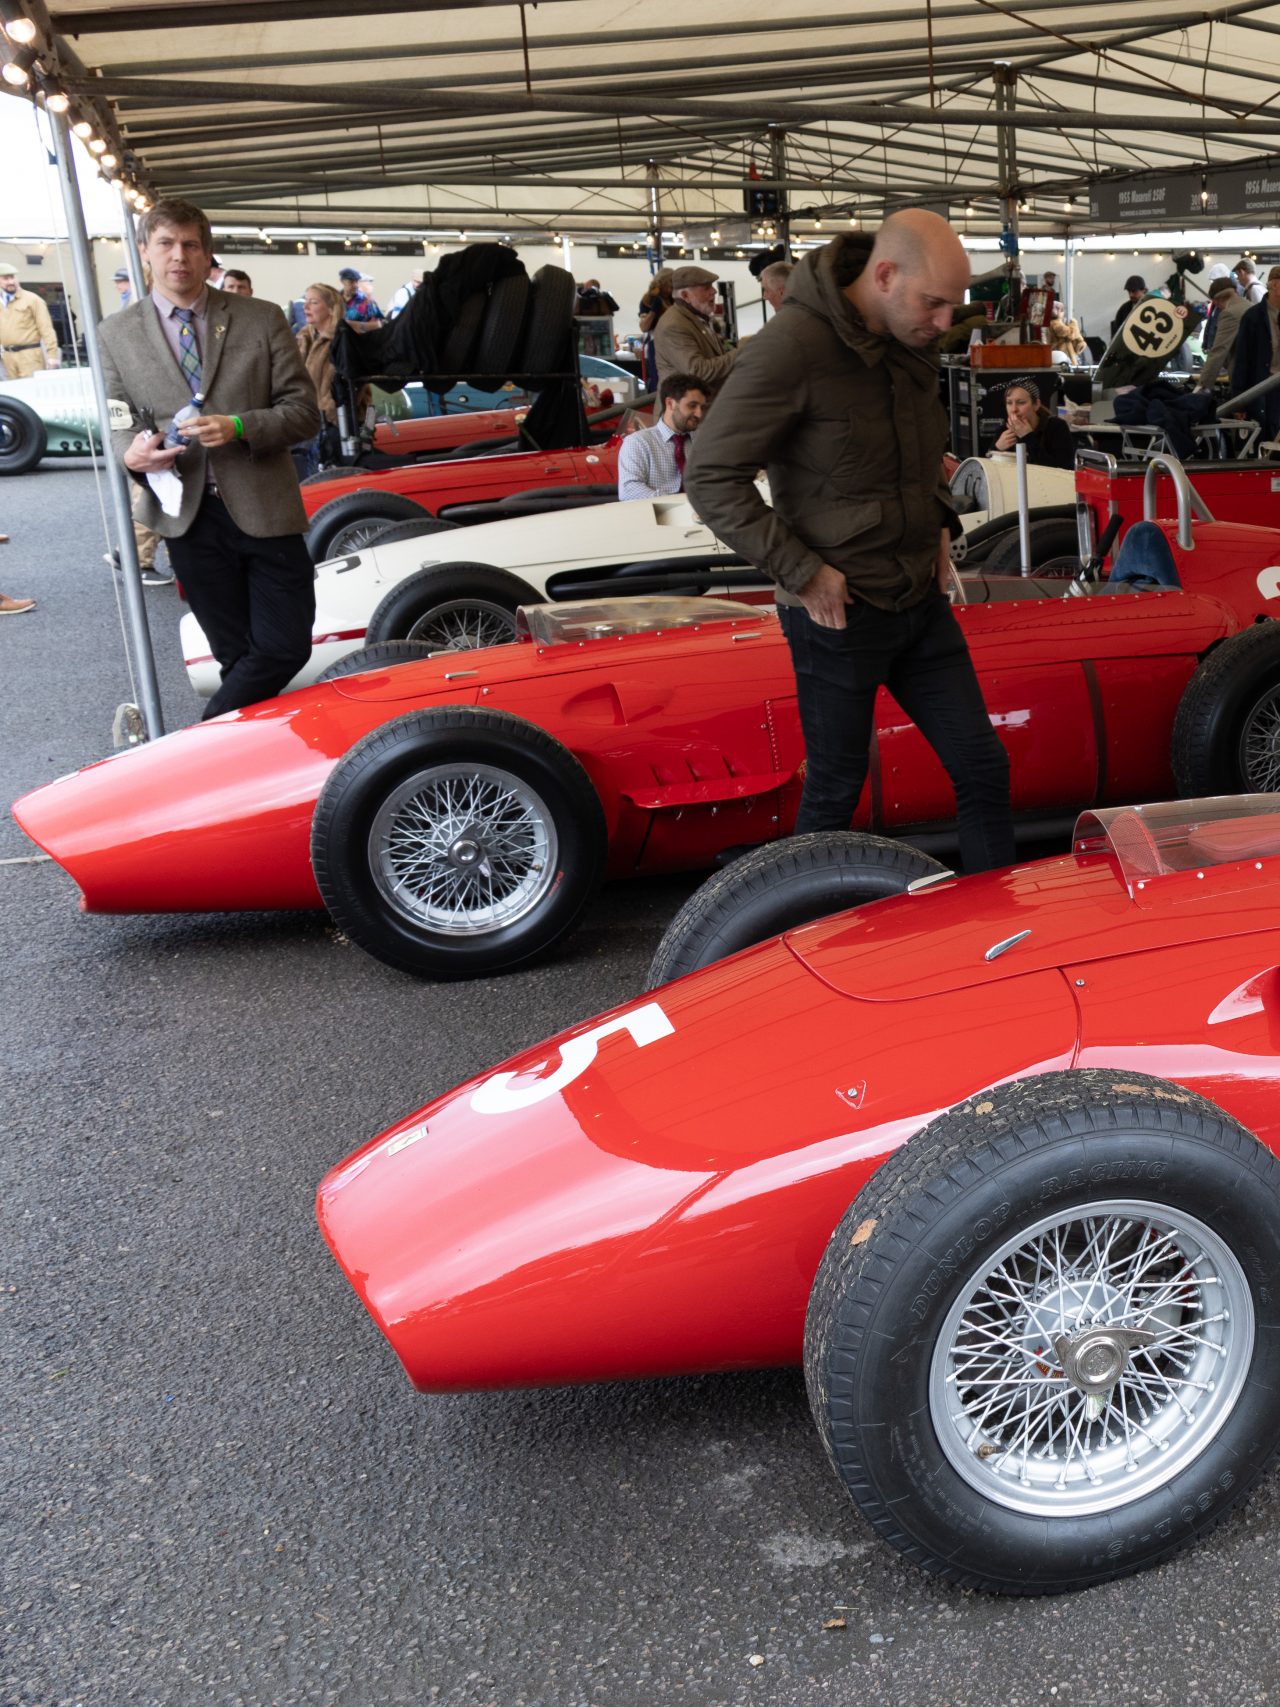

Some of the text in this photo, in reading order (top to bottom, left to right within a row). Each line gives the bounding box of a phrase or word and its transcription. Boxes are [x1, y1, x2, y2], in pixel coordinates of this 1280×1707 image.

[1130, 306, 1173, 351] 43
[470, 1002, 676, 1114] 5
[911, 1160, 1169, 1320] DUNLOP RACING
